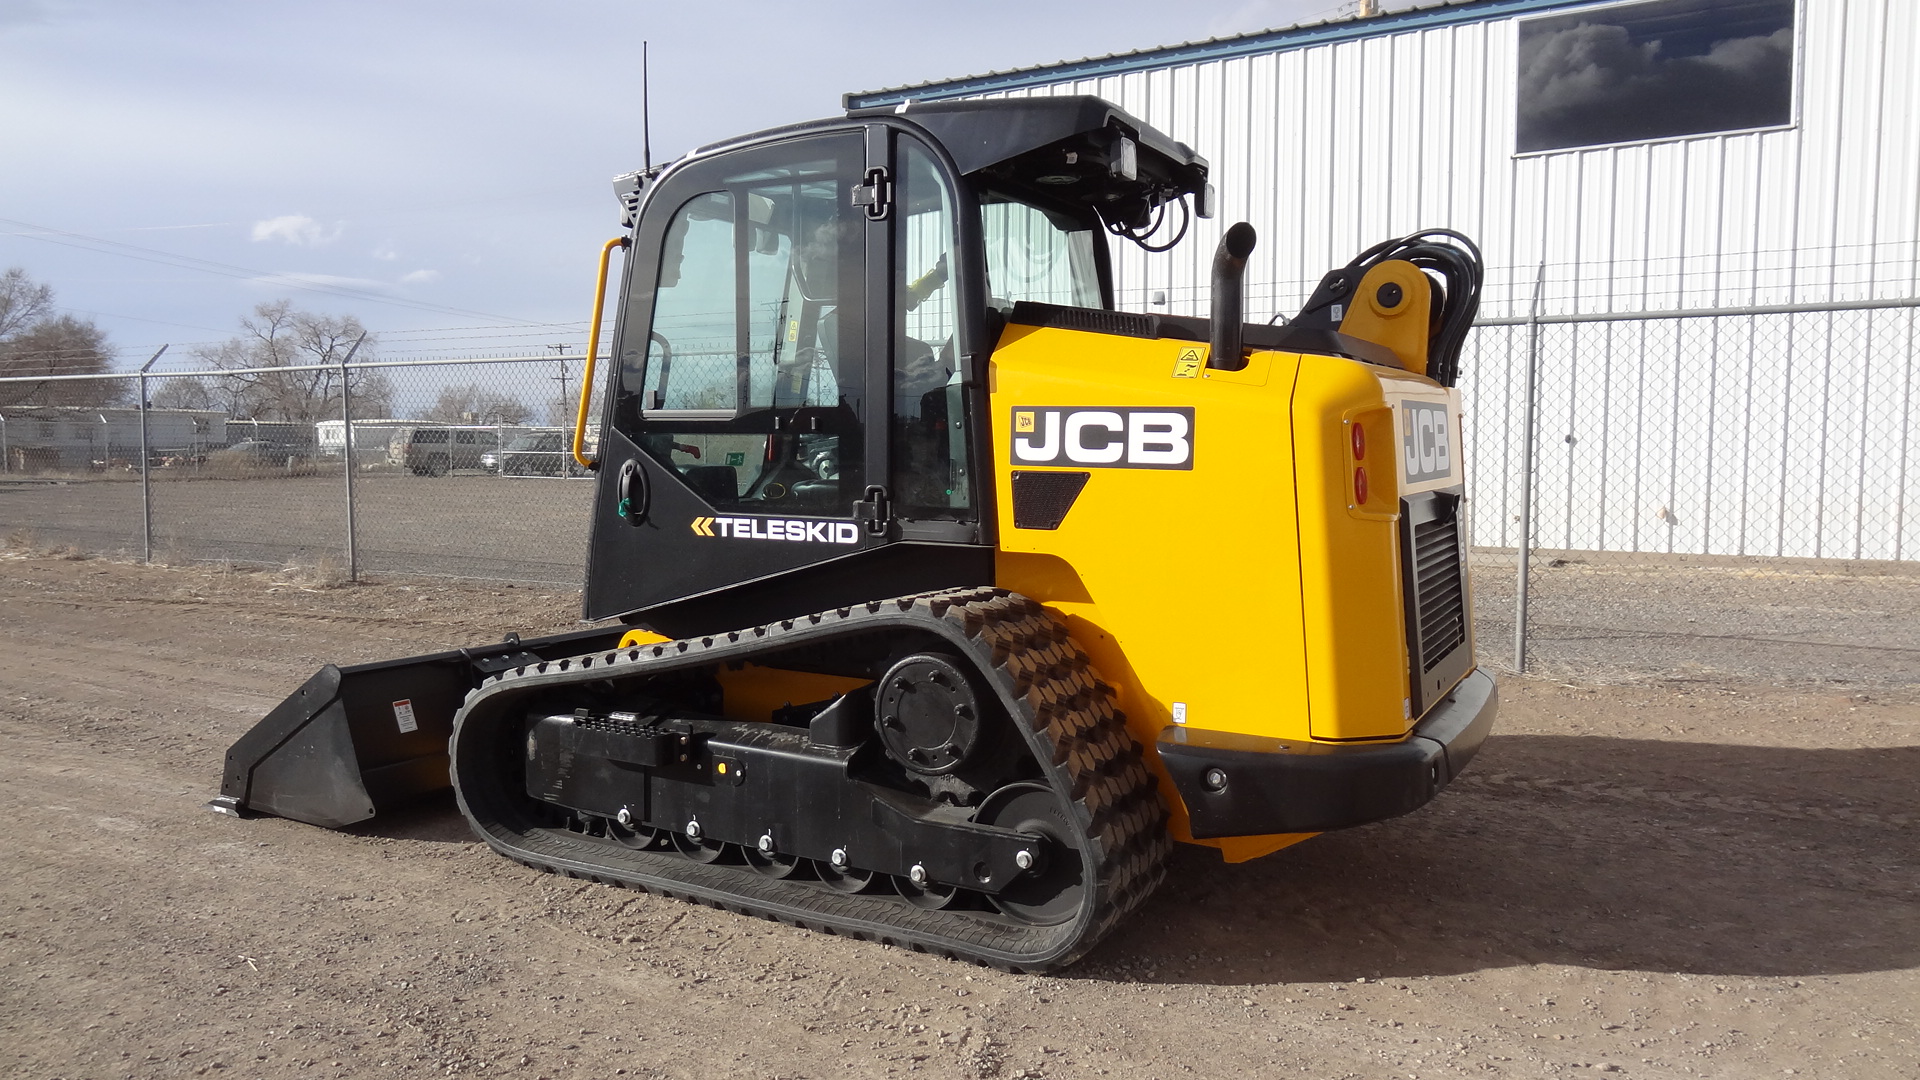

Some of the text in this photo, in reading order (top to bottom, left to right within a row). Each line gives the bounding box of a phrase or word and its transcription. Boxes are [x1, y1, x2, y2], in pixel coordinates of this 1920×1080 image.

[1015, 411, 1190, 465] JCB
[1405, 408, 1450, 476] JCB
[715, 517, 859, 544] TELESKID
